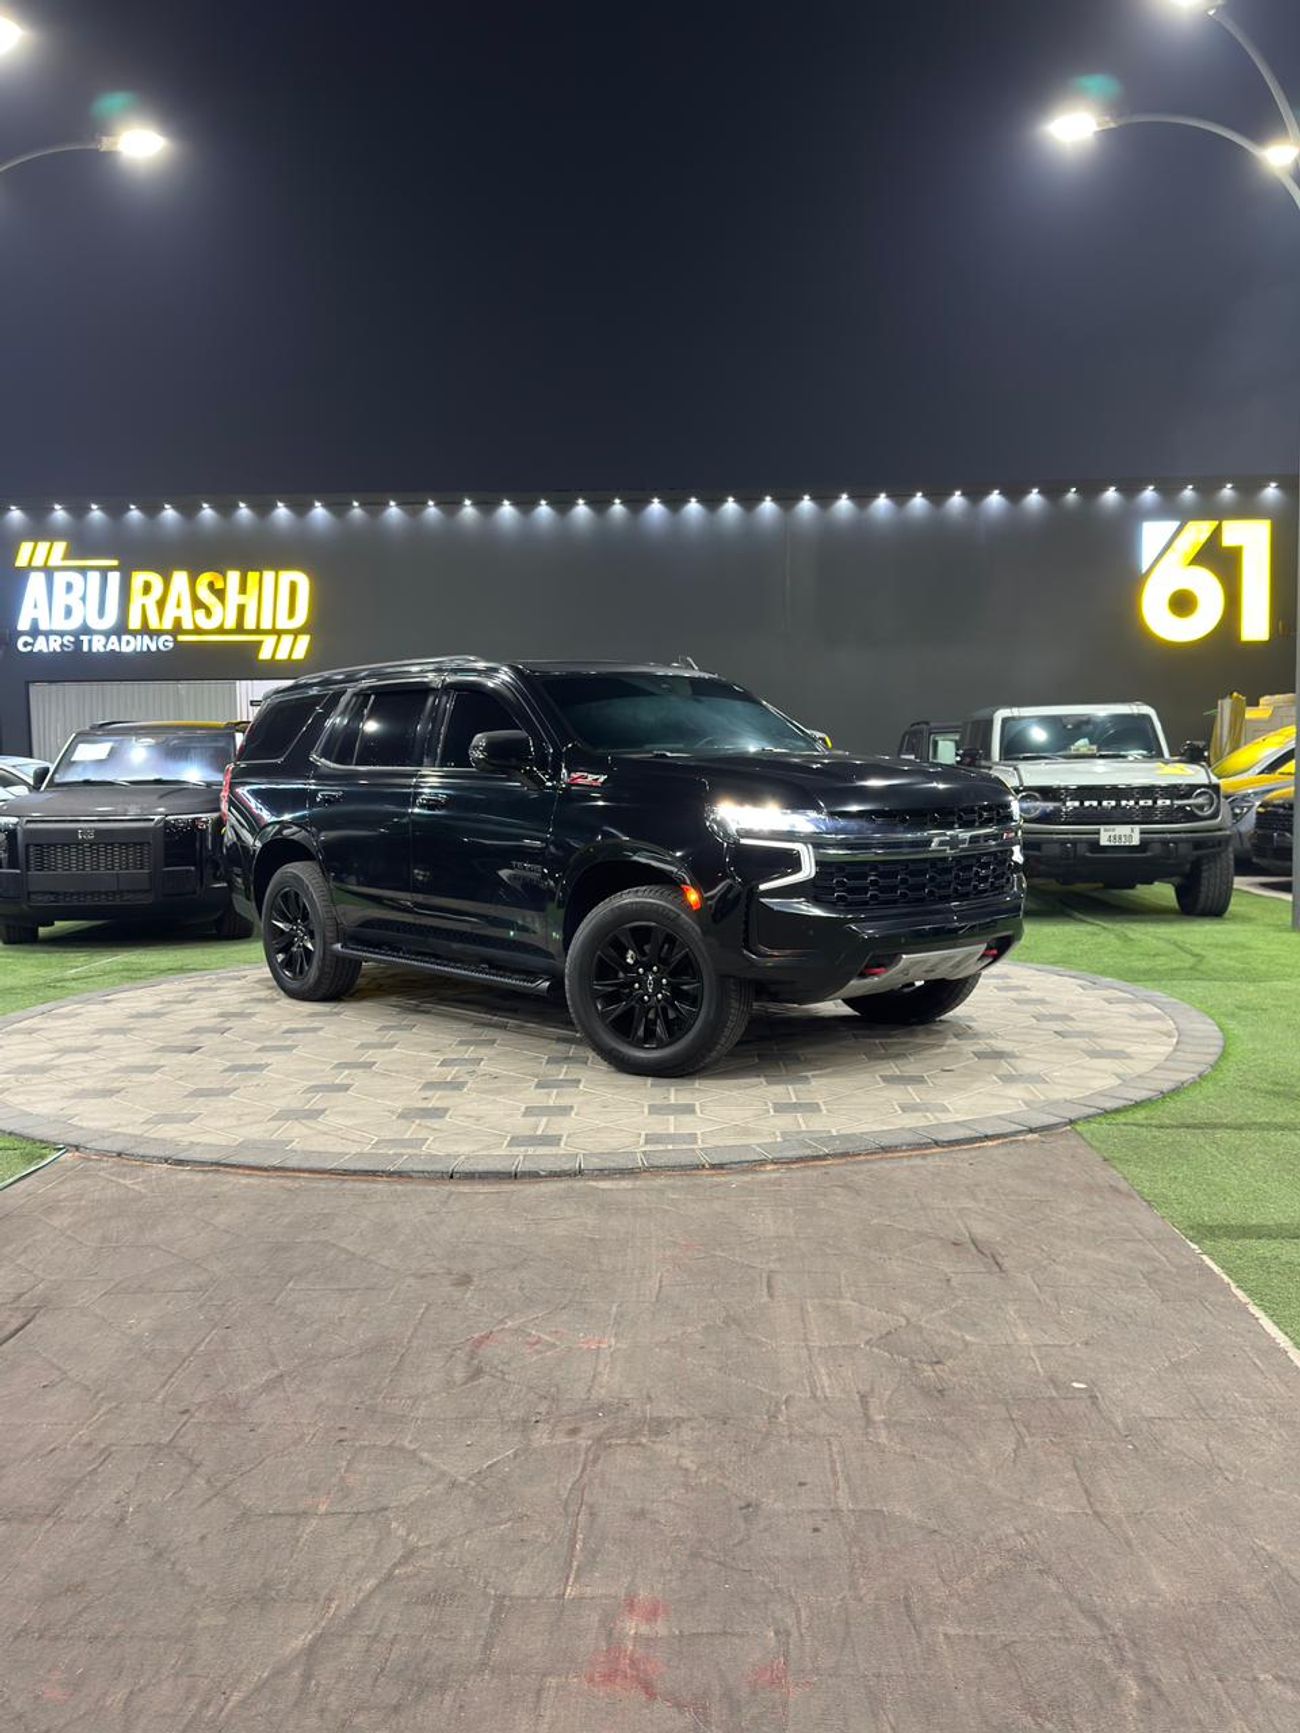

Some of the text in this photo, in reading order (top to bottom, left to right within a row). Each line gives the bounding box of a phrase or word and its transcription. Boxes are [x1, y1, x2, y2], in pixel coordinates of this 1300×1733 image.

[17, 570, 311, 631] ABU RASHID
[1141, 519, 1272, 643] 61
[17, 635, 174, 652] CARS TRADING
[1065, 799, 1171, 807] BRONCO
